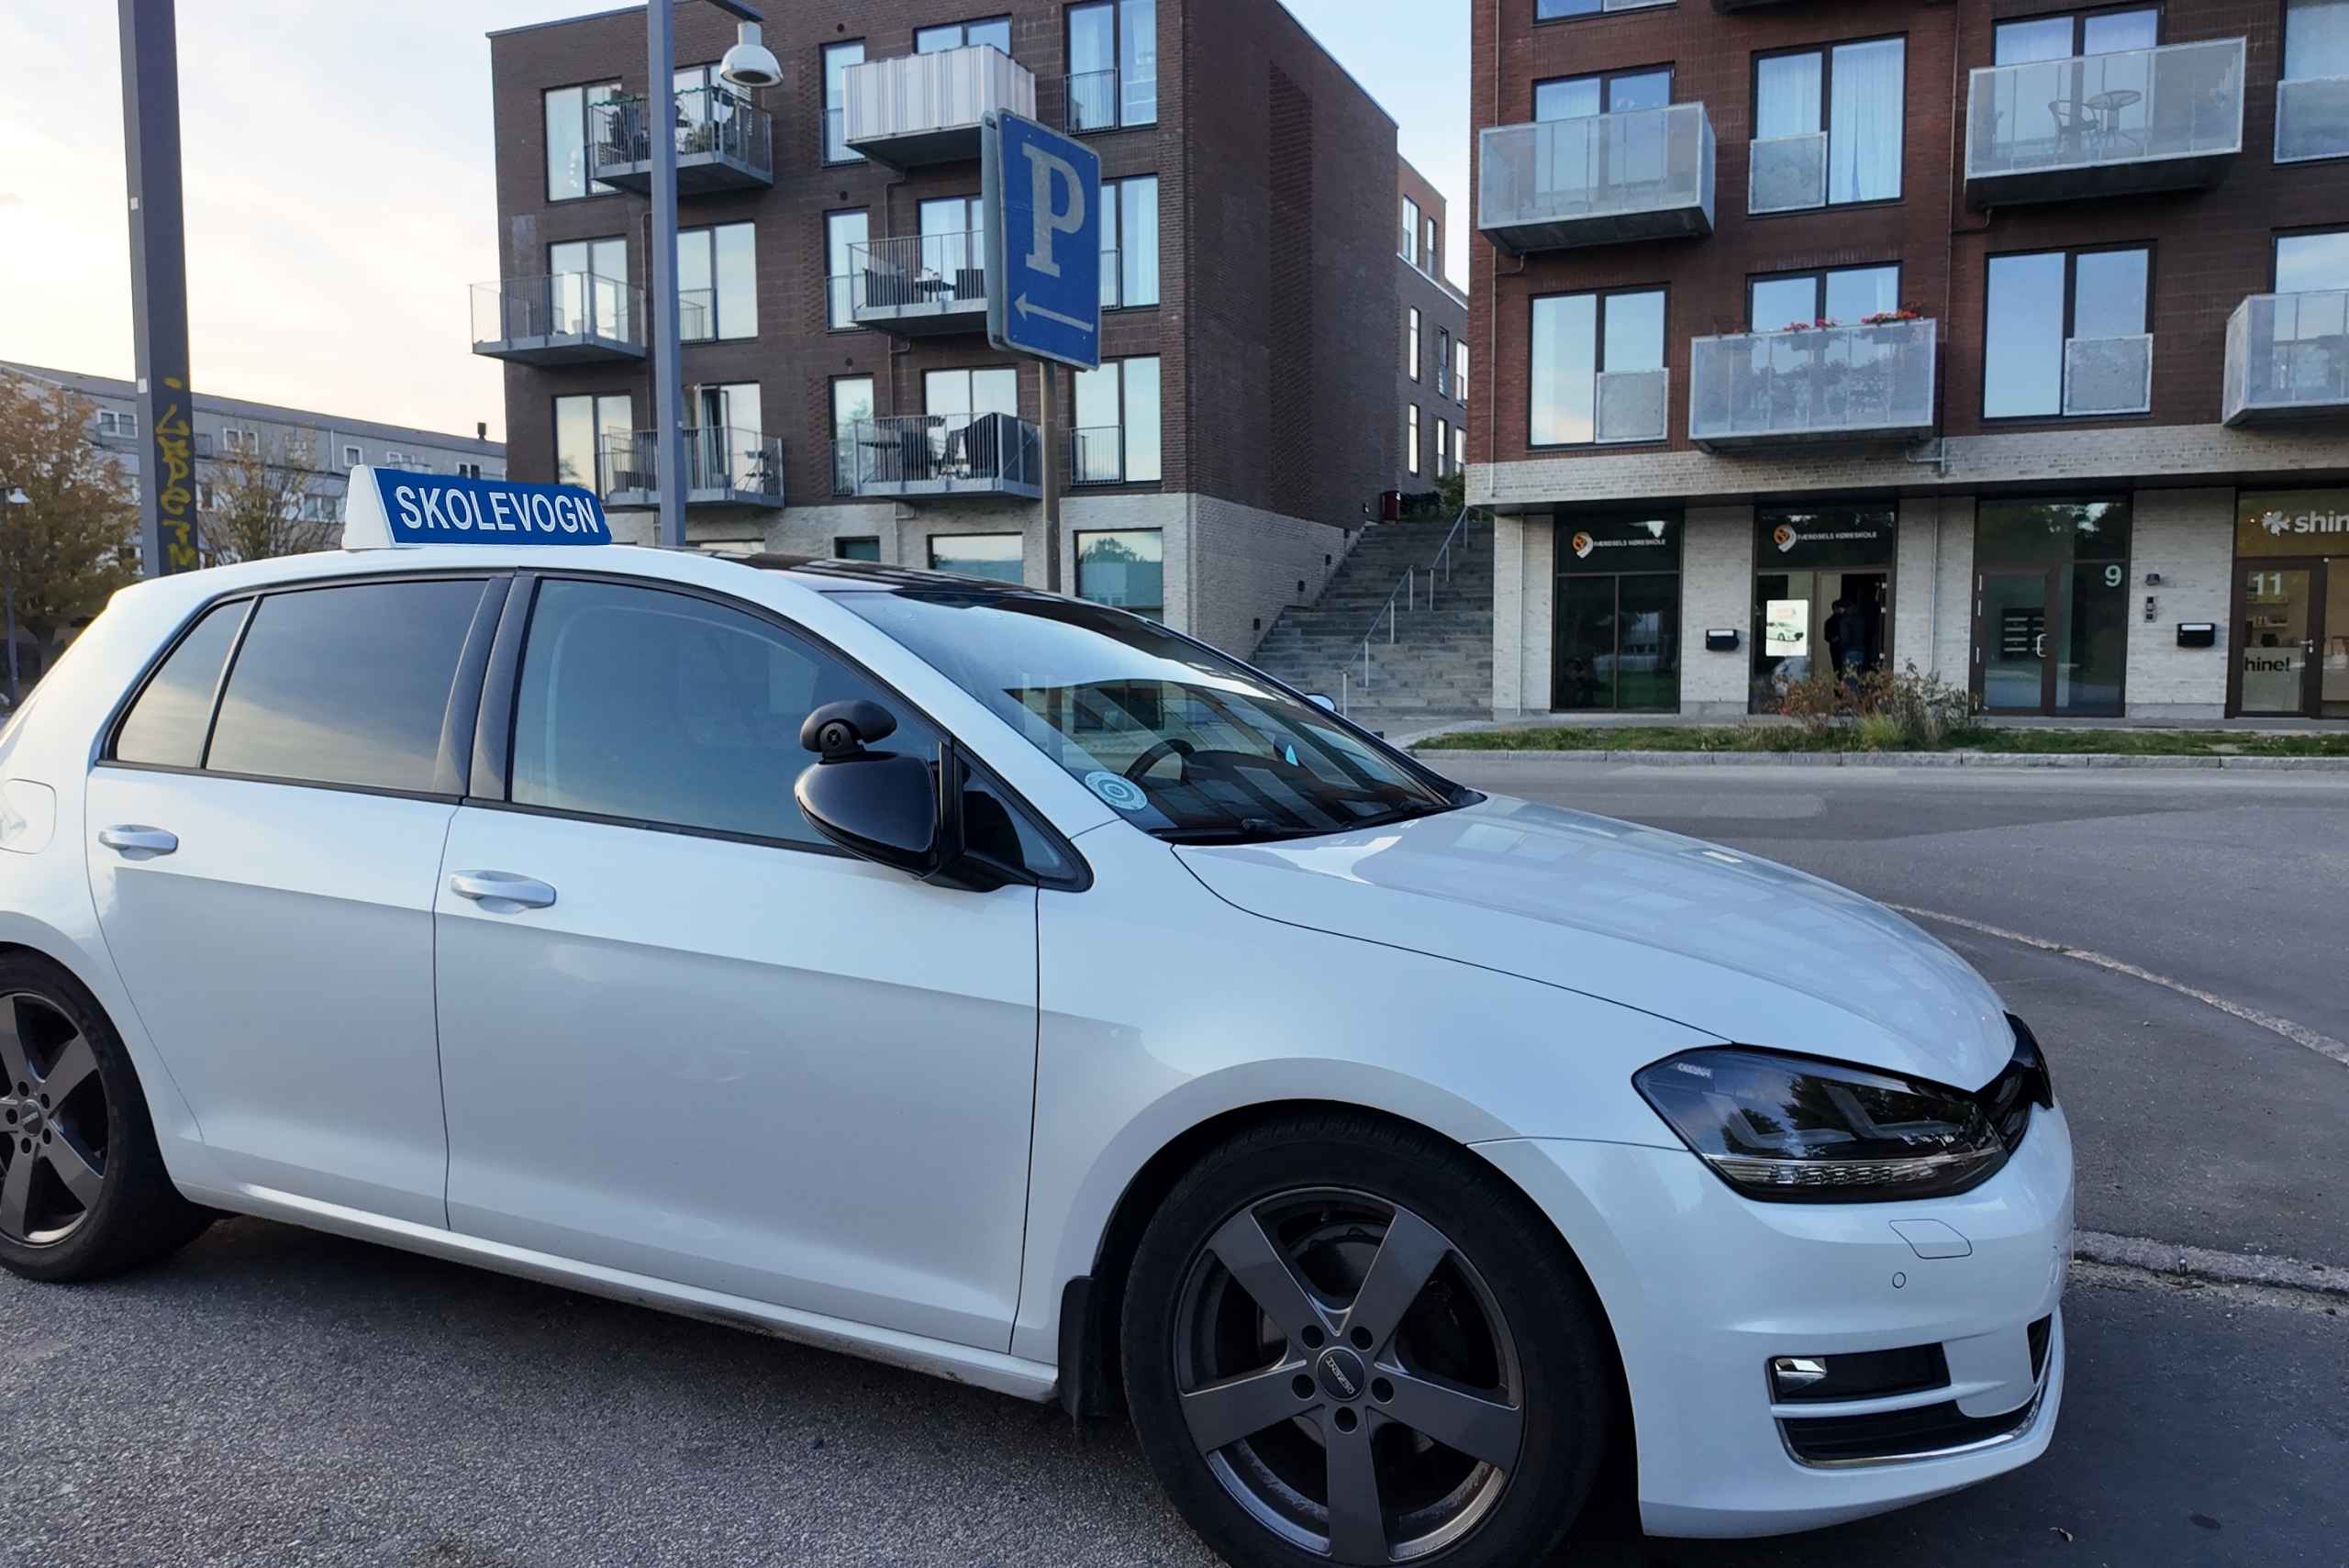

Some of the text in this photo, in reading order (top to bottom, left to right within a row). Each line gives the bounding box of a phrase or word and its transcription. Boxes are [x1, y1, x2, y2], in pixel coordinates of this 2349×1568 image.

[1022, 142, 1085, 278] P
[395, 484, 600, 534] SKOLEVOGN
[2293, 510, 2349, 533] shin
[2105, 564, 2122, 587] 9
[2252, 572, 2282, 595] 11
